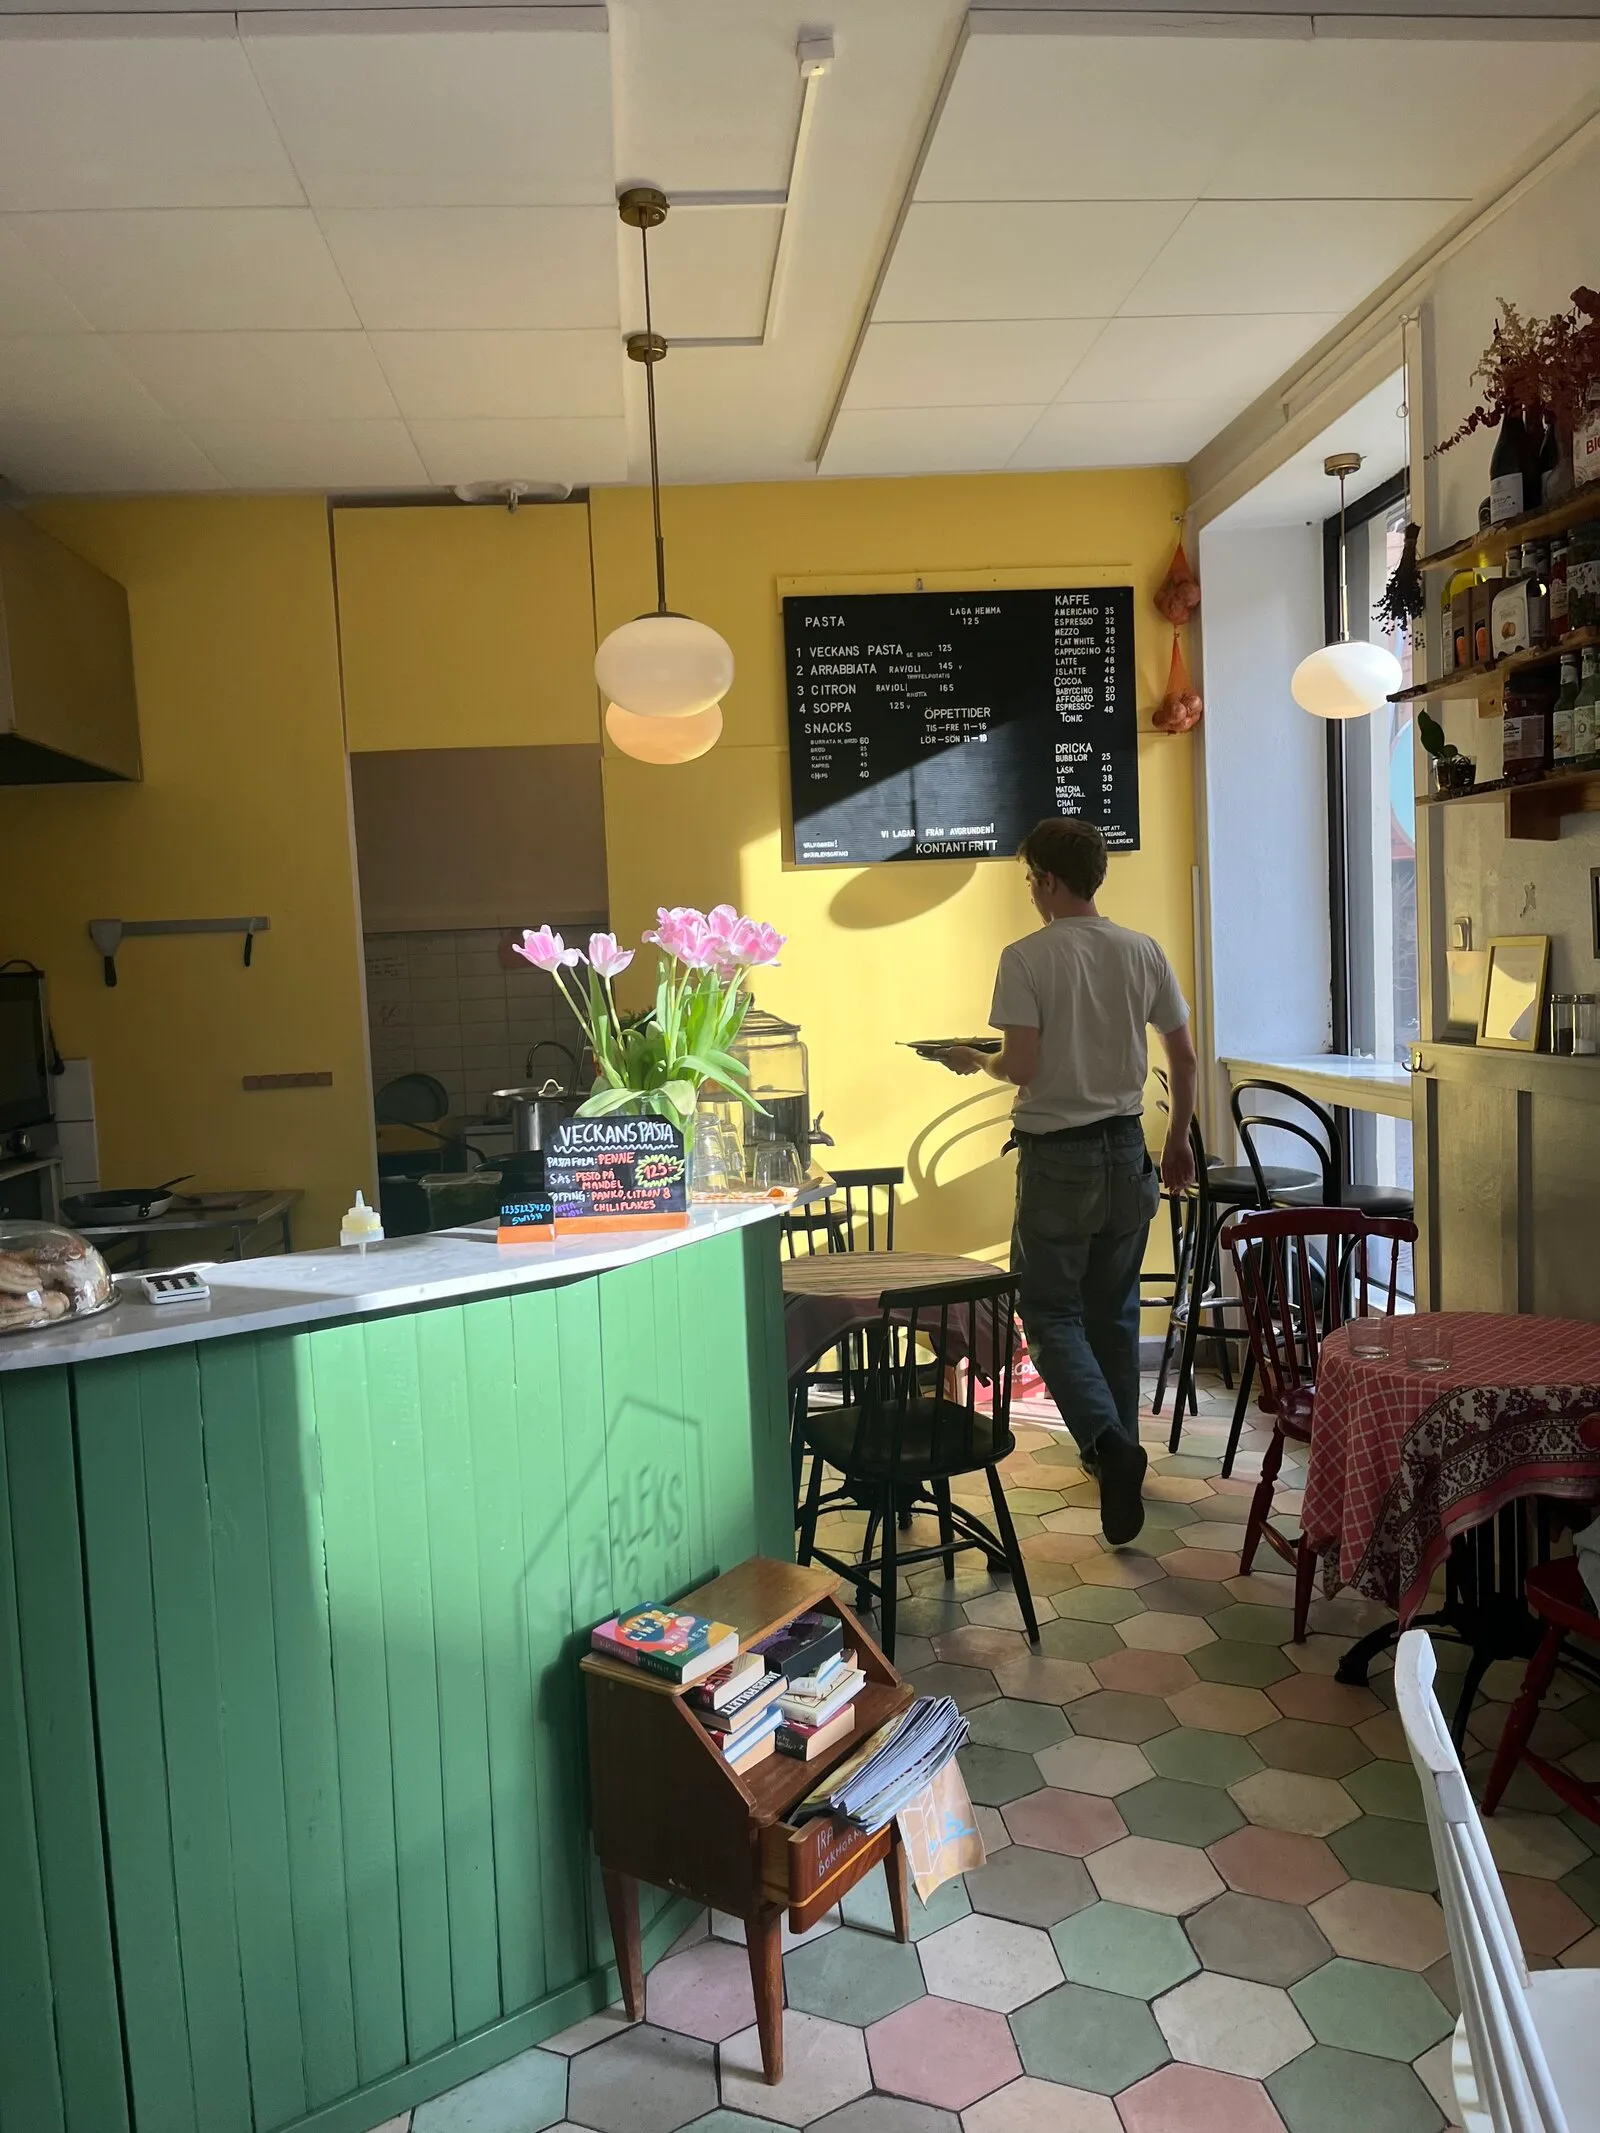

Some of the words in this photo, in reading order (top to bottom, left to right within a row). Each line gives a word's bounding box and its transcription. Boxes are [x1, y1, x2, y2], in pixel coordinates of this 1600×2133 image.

[1055, 595, 1090, 606] KAFFE
[950, 607, 971, 616] LAGA
[975, 606, 1001, 615] HEMMA
[1055, 608, 1099, 616] AMERICANO
[1105, 607, 1115, 615] 35
[805, 616, 845, 628] PASTA
[962, 617, 980, 625] 125
[1055, 618, 1094, 626] ESPRESSO
[1105, 617, 1115, 625] 32
[1055, 628, 1080, 636] MEZZO
[1106, 627, 1116, 635] 38
[1055, 638, 1072, 646] FLAT
[1074, 637, 1095, 645] WHITE
[796, 648, 801, 658] 1
[809, 646, 860, 658] VECKANS
[868, 644, 904, 656] PASTA
[938, 644, 953, 652] 125
[1055, 647, 1101, 656] CAPPUCCINO
[1106, 646, 1116, 654] 45
[1056, 657, 1078, 666] LATTE
[796, 665, 804, 676] 2
[810, 663, 877, 676] ARRABBIATA
[889, 664, 921, 674] RAVIOLI
[938, 661, 953, 670] 145
[1056, 667, 1087, 676] ISLATTE
[1104, 676, 1115, 684] 45
[797, 685, 805, 696] 3
[811, 684, 857, 696] CITRON
[876, 683, 908, 692] RAVIOLI
[940, 684, 954, 692] 165
[1056, 687, 1094, 696] BABYCCINO
[1106, 686, 1116, 694] 20
[1056, 695, 1094, 704] AFFOGATO
[1106, 694, 1116, 702] 50
[799, 703, 806, 714] 4
[813, 702, 852, 714] SOPPA
[889, 701, 905, 710] 125
[1104, 706, 1114, 714] 48
[924, 707, 991, 720] ÖPPETTIDER
[804, 722, 852, 734] SNACKS
[860, 736, 870, 745] 60
[1055, 743, 1093, 754] DRICKA
[1101, 753, 1111, 761] 25
[859, 770, 870, 778] 40
[1056, 765, 1074, 774] LÄSK
[1057, 776, 1066, 784] TE
[1056, 785, 1081, 794] MATCHA
[1102, 784, 1113, 792] 50
[1057, 800, 1074, 808] CHAI
[1062, 807, 1082, 815] DIRTY
[881, 830, 889, 839] VI
[893, 830, 916, 838] LAGAR
[925, 827, 945, 837] FRÅN
[950, 822, 995, 836] AVGRUNDEN!
[560, 1122, 638, 1147] VECKANS
[638, 1121, 674, 1143] PASTA
[598, 1152, 636, 1165] PENNE
[575, 1171, 601, 1183] PESTO
[582, 1181, 624, 1191] MANDEL
[626, 1189, 660, 1200] CITRON
[512, 1212, 543, 1226] SWISH
[752, 1670, 782, 1691] JAMES
[720, 1688, 761, 1716] FOLLETT
